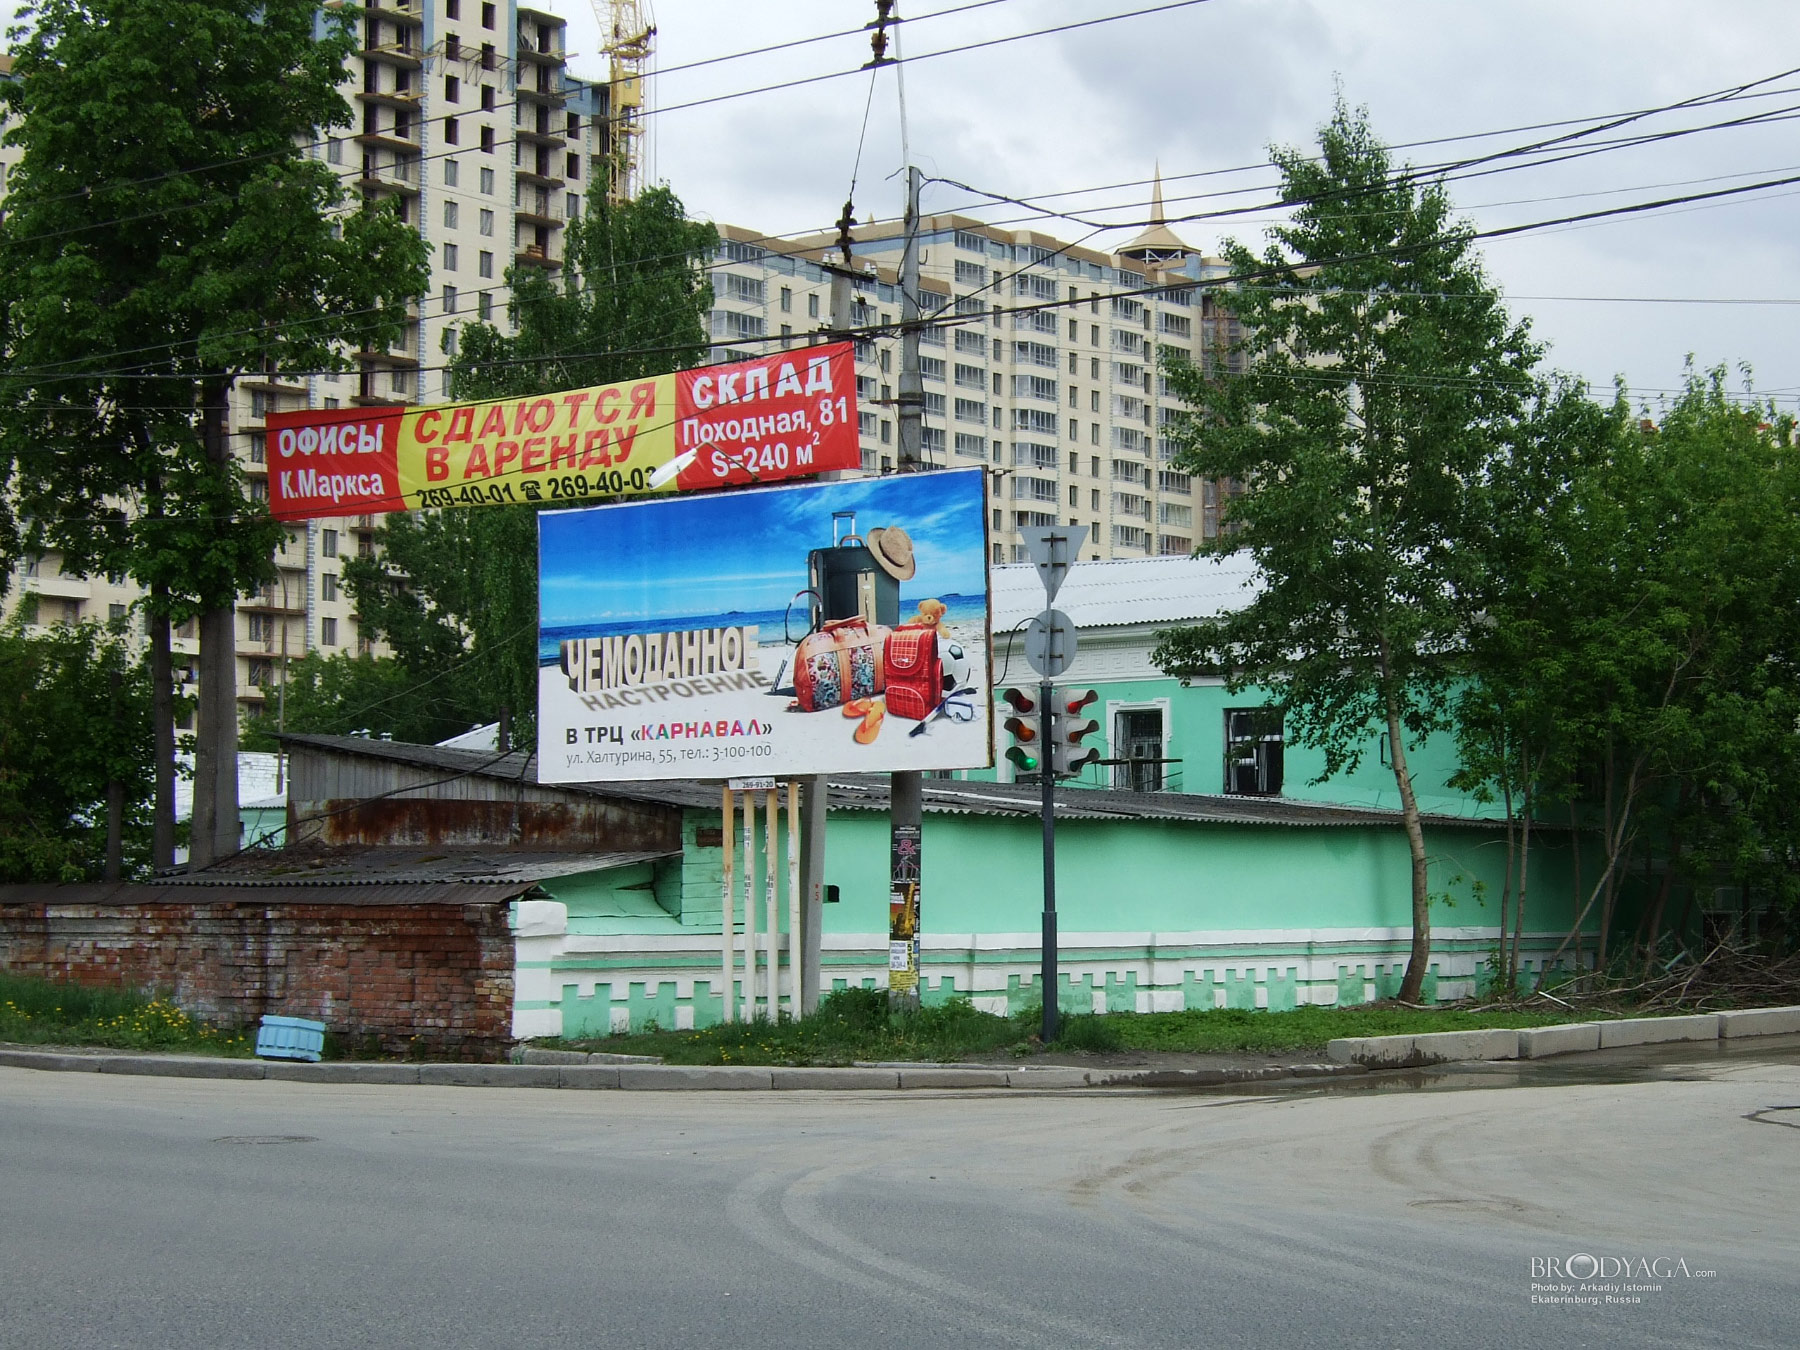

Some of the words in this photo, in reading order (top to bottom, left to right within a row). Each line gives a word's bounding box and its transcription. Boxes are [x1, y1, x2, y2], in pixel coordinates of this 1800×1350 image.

[692, 356, 833, 409] СКЛАД
[414, 382, 656, 445] СДАЮТСЯ
[683, 410, 812, 446] Походная,
[819, 397, 848, 426] 81
[279, 424, 384, 458] ОФИСЫ
[426, 447, 449, 481] В
[463, 424, 638, 479] АРЕНДУ
[711, 442, 789, 477] S=240
[281, 469, 385, 504] К.Маркса
[416, 483, 516, 508] 269-40-01
[561, 625, 759, 693] ЧЕМОДАННОЕ
[579, 670, 774, 711] НАСТРОЕНИЕ
[566, 728, 577, 744] В
[585, 726, 623, 745] ТРЦ
[631, 719, 772, 740] «КАРНАВАЛ»
[566, 753, 583, 767] ул.
[586, 748, 655, 766] Халтурина,
[659, 748, 676, 762] 55,
[680, 746, 709, 760] тел.:
[712, 744, 772, 761] 3-100-100
